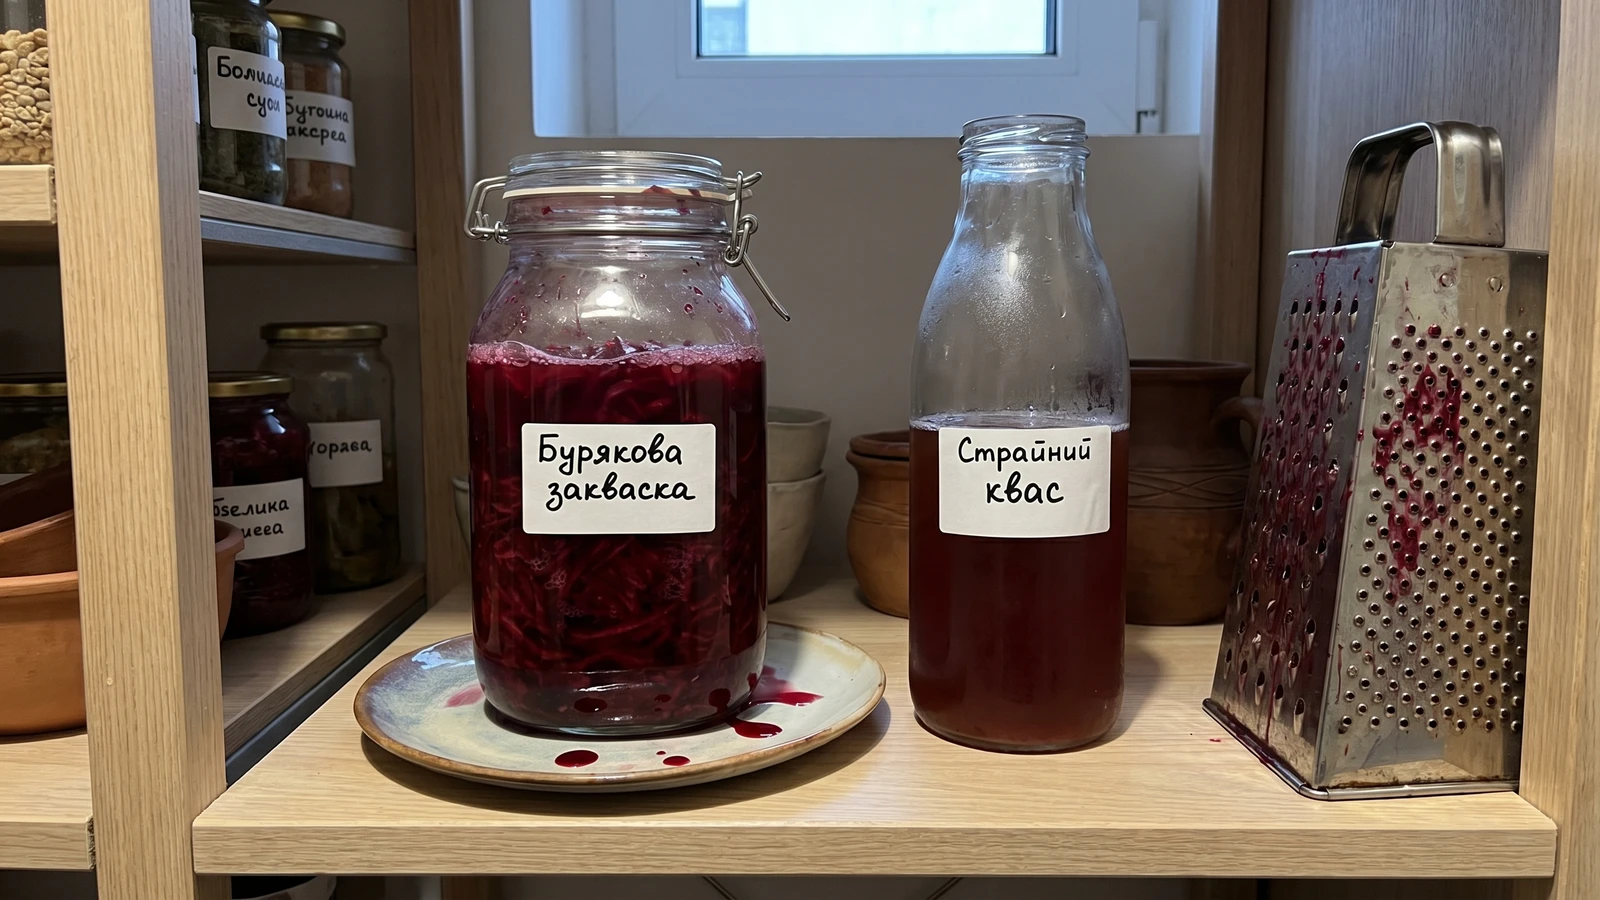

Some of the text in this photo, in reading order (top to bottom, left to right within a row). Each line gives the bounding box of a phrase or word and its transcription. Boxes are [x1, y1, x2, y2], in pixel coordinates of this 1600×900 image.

[539, 433, 682, 476] Бурякова
[545, 471, 696, 511] закваска
[986, 471, 1064, 504] квас
